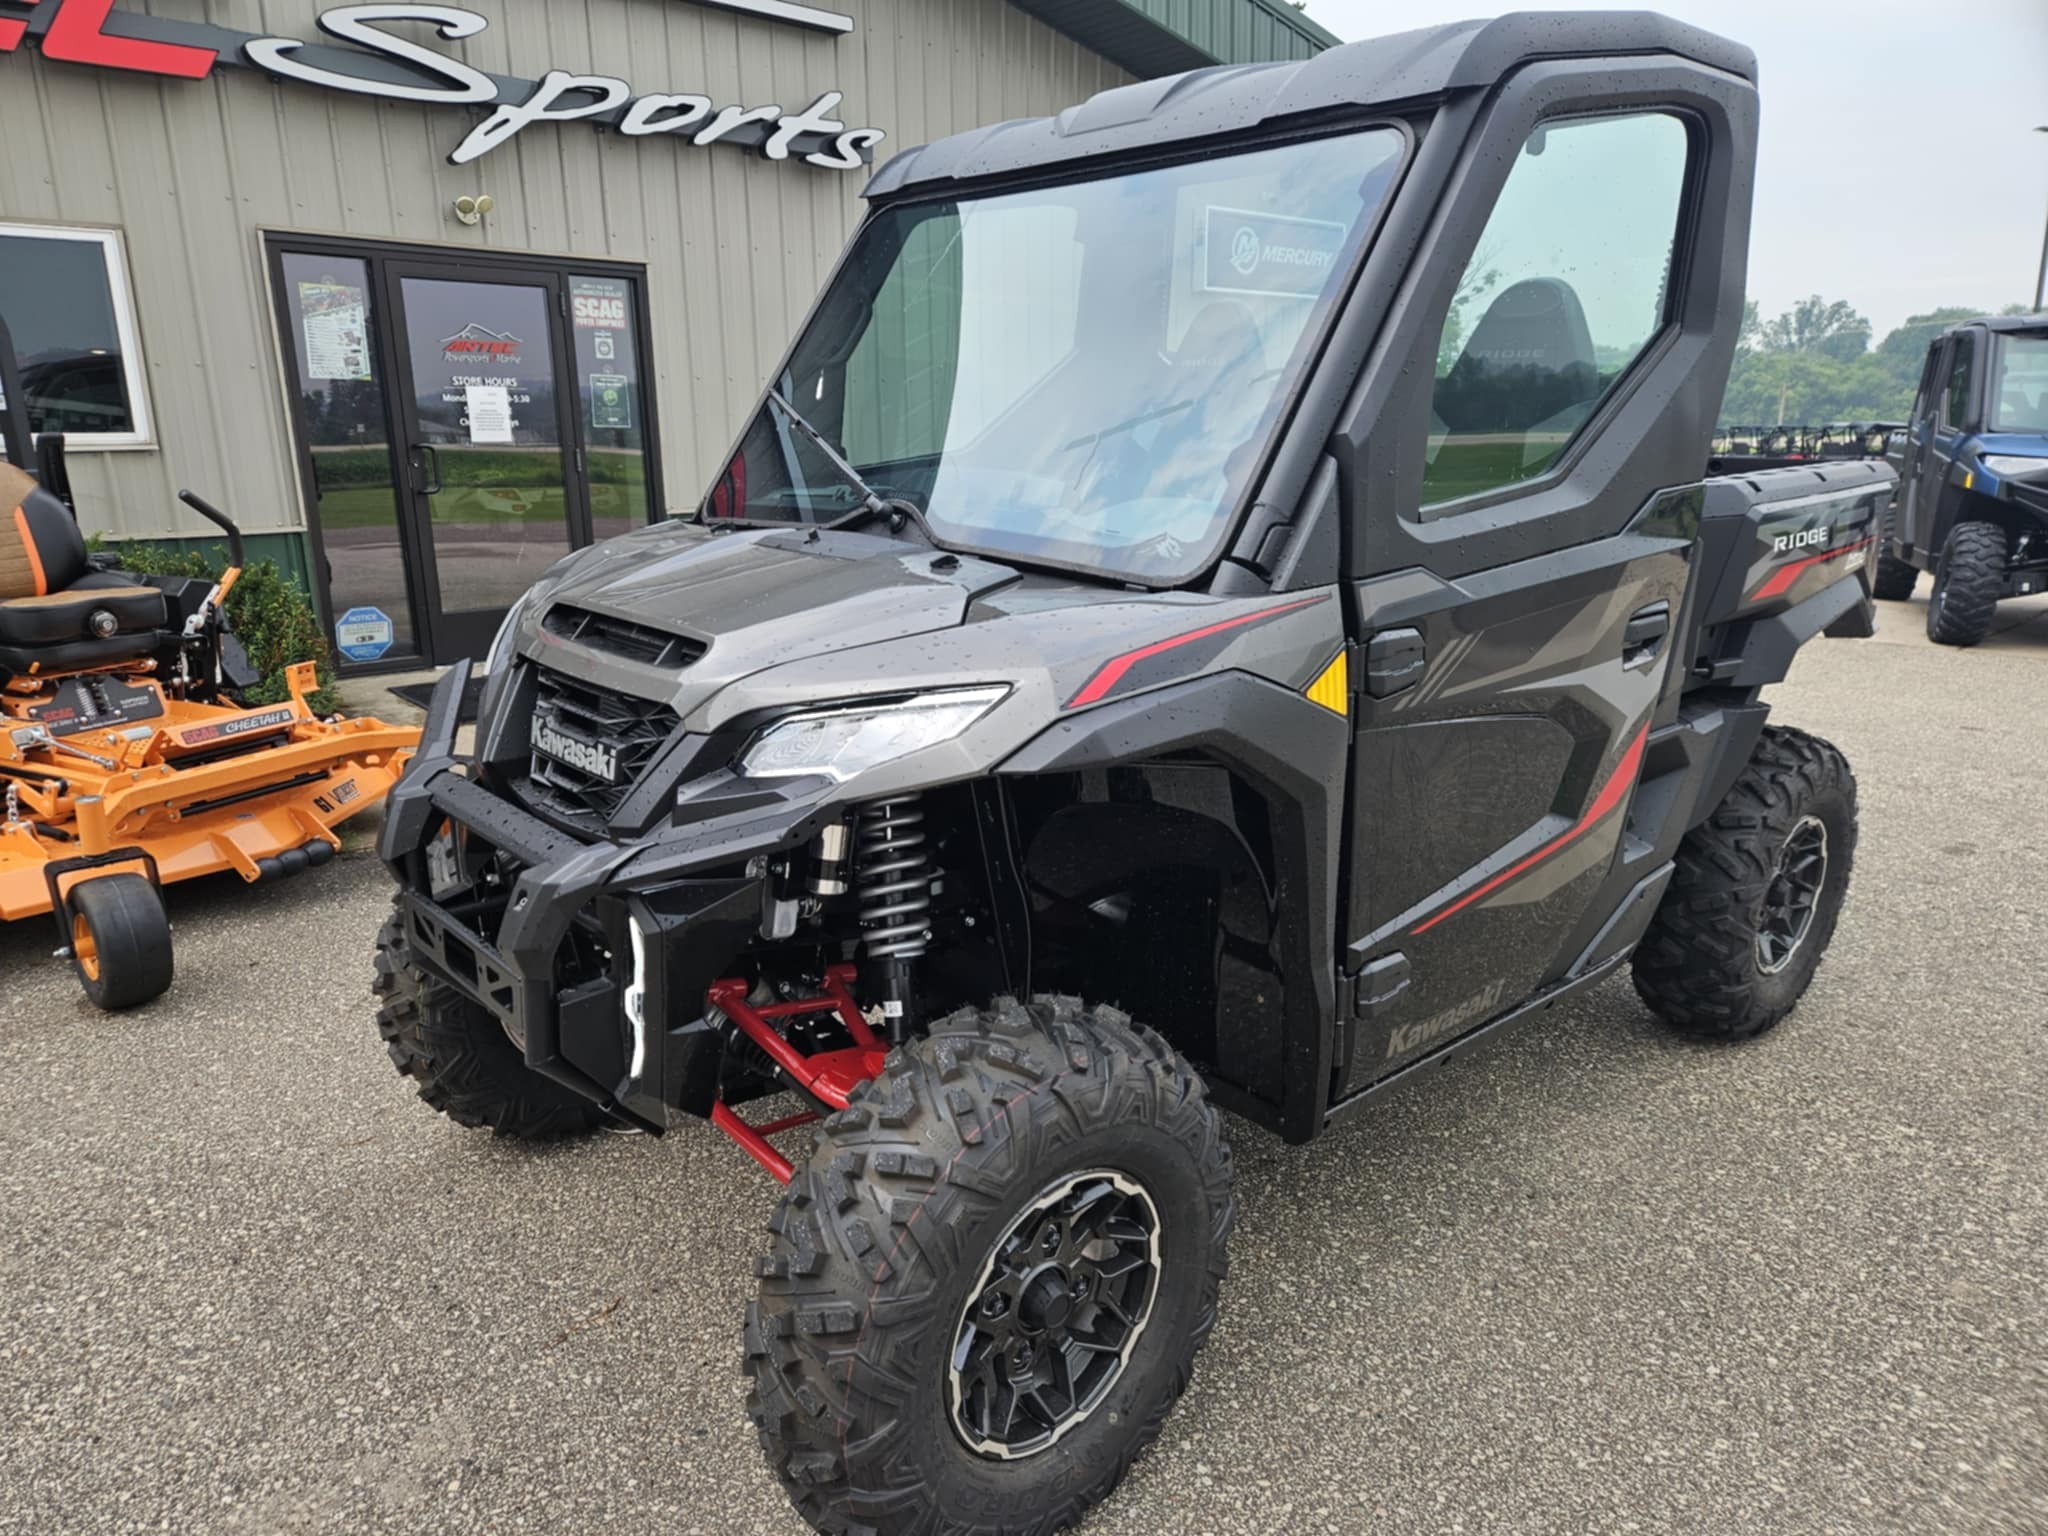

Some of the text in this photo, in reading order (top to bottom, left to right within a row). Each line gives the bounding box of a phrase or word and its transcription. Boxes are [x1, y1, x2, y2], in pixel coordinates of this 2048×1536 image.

[243, 3, 886, 170] Sports
[1262, 245, 1333, 267] MERCURY
[575, 297, 625, 318] SCAG
[452, 375, 518, 387] STORE HOURS
[442, 393, 467, 402] Mond
[1773, 526, 1829, 552] RIDGE
[225, 711, 280, 734] CHEETAH
[530, 714, 617, 781] Kawasaki
[1386, 977, 1506, 1060] Kawasaki
